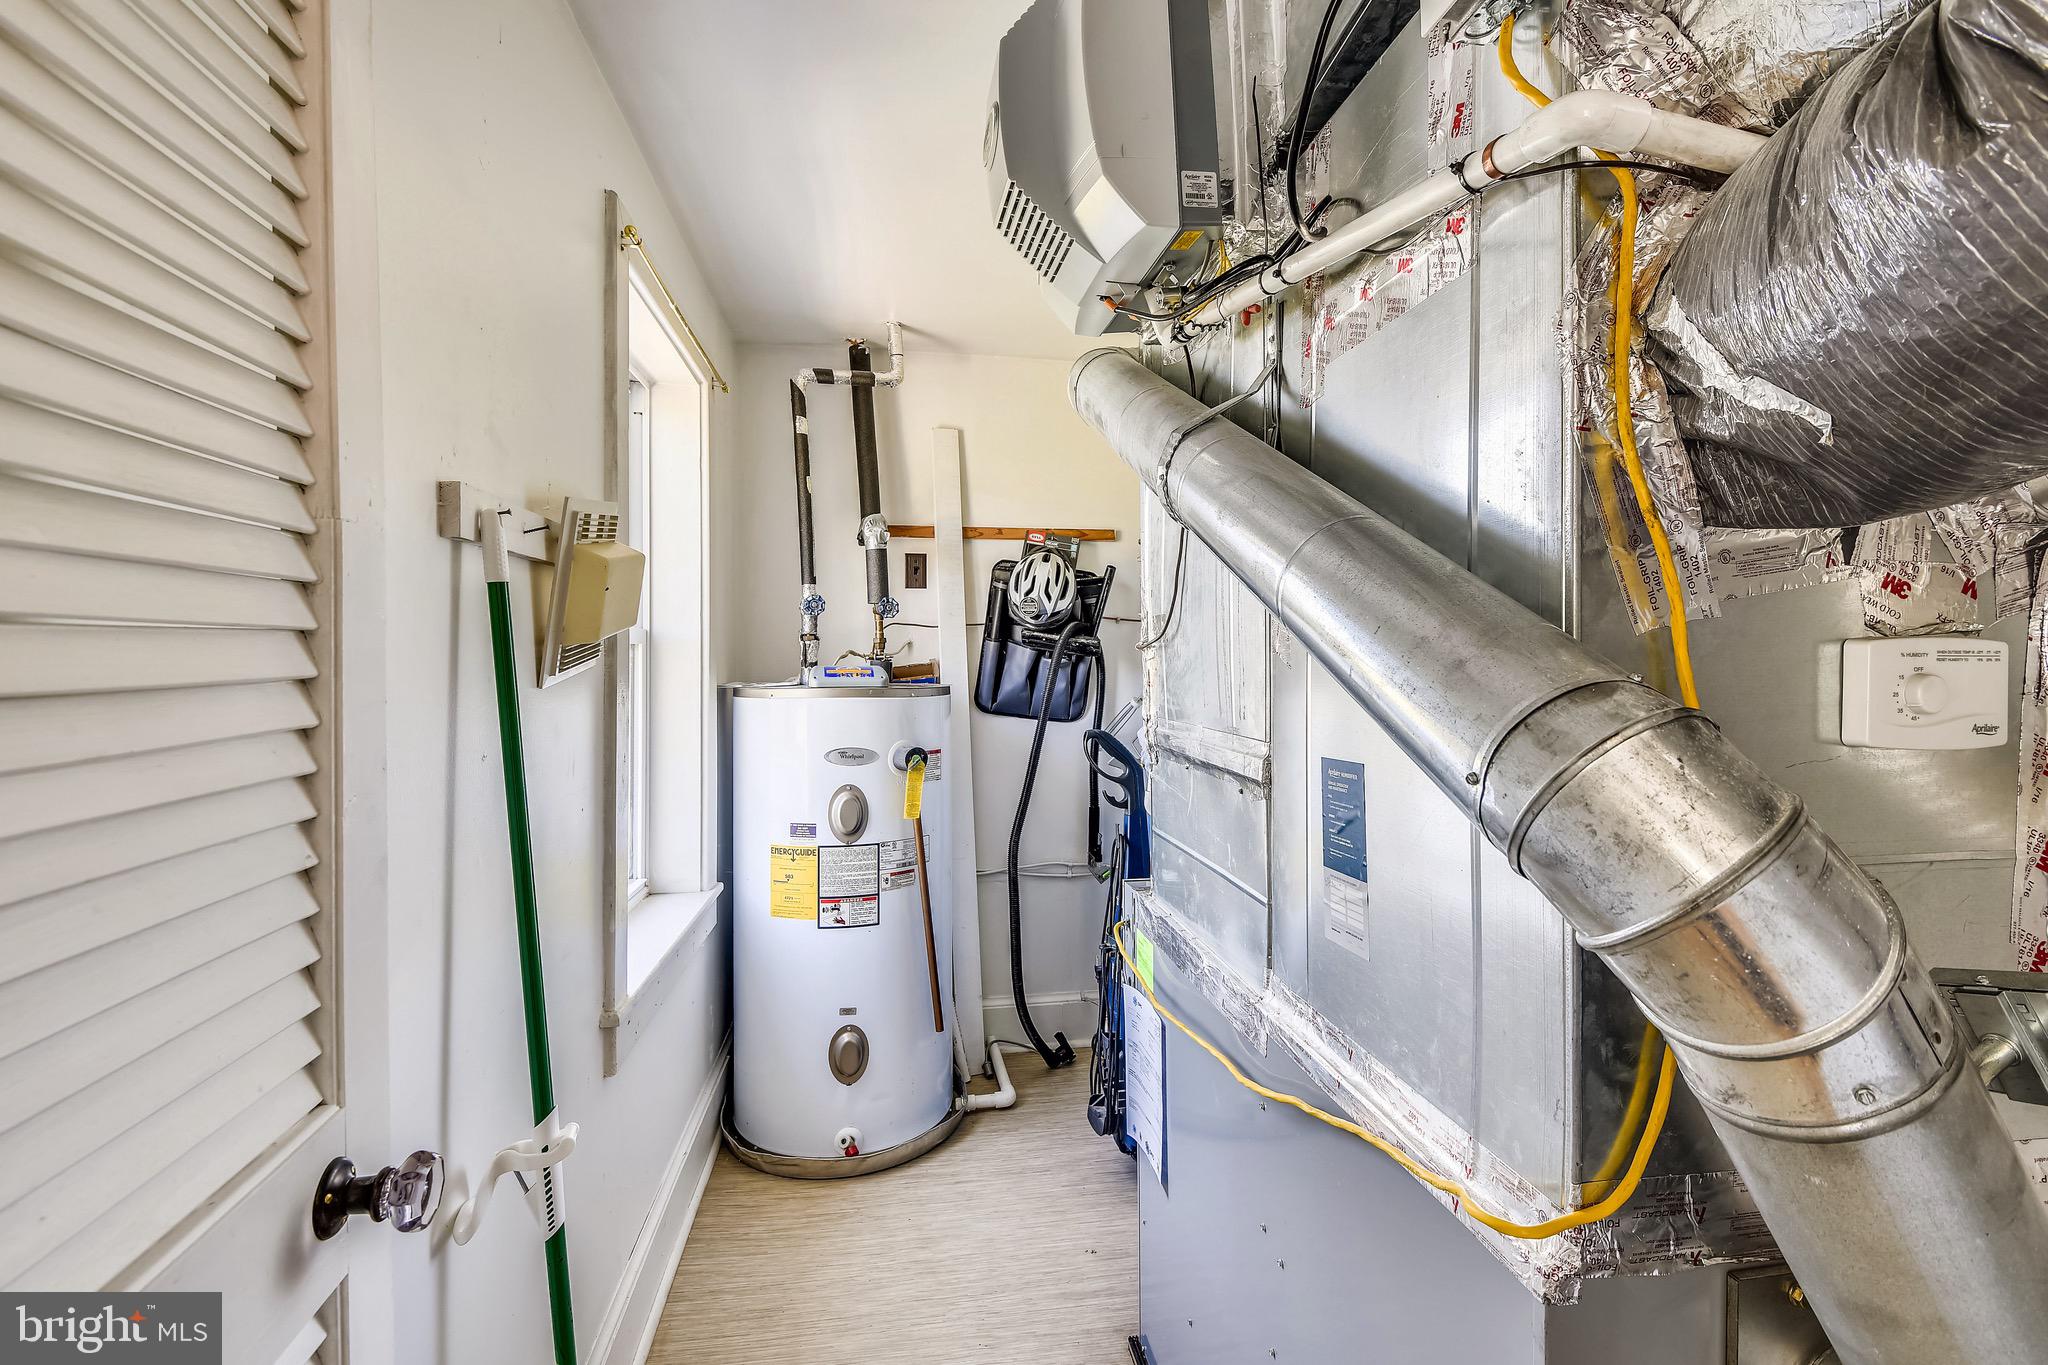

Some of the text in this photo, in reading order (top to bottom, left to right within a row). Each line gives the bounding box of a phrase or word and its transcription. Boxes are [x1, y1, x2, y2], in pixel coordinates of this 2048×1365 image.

[1661, 31, 1698, 74] FOIL-GRIP
[1662, 52, 1682, 74] 1402
[1451, 102, 1466, 139] 3M
[1445, 216, 1466, 236] 3M
[1676, 544, 1698, 597] FOIL-GRIP
[1690, 554, 1702, 578] 1402
[1898, 568, 1917, 583] 3340
[1638, 559, 1660, 612] FOIL-GRIP
[1651, 570, 1664, 593] 1402
[1880, 571, 1912, 600] 3M
[1880, 604, 1902, 620] COLD
[1971, 723, 2000, 735] Aprilaire
[2035, 832, 2047, 854] 3340
[2026, 935, 2039, 958] 3340
[1629, 1253, 1688, 1265] HARDCAST
